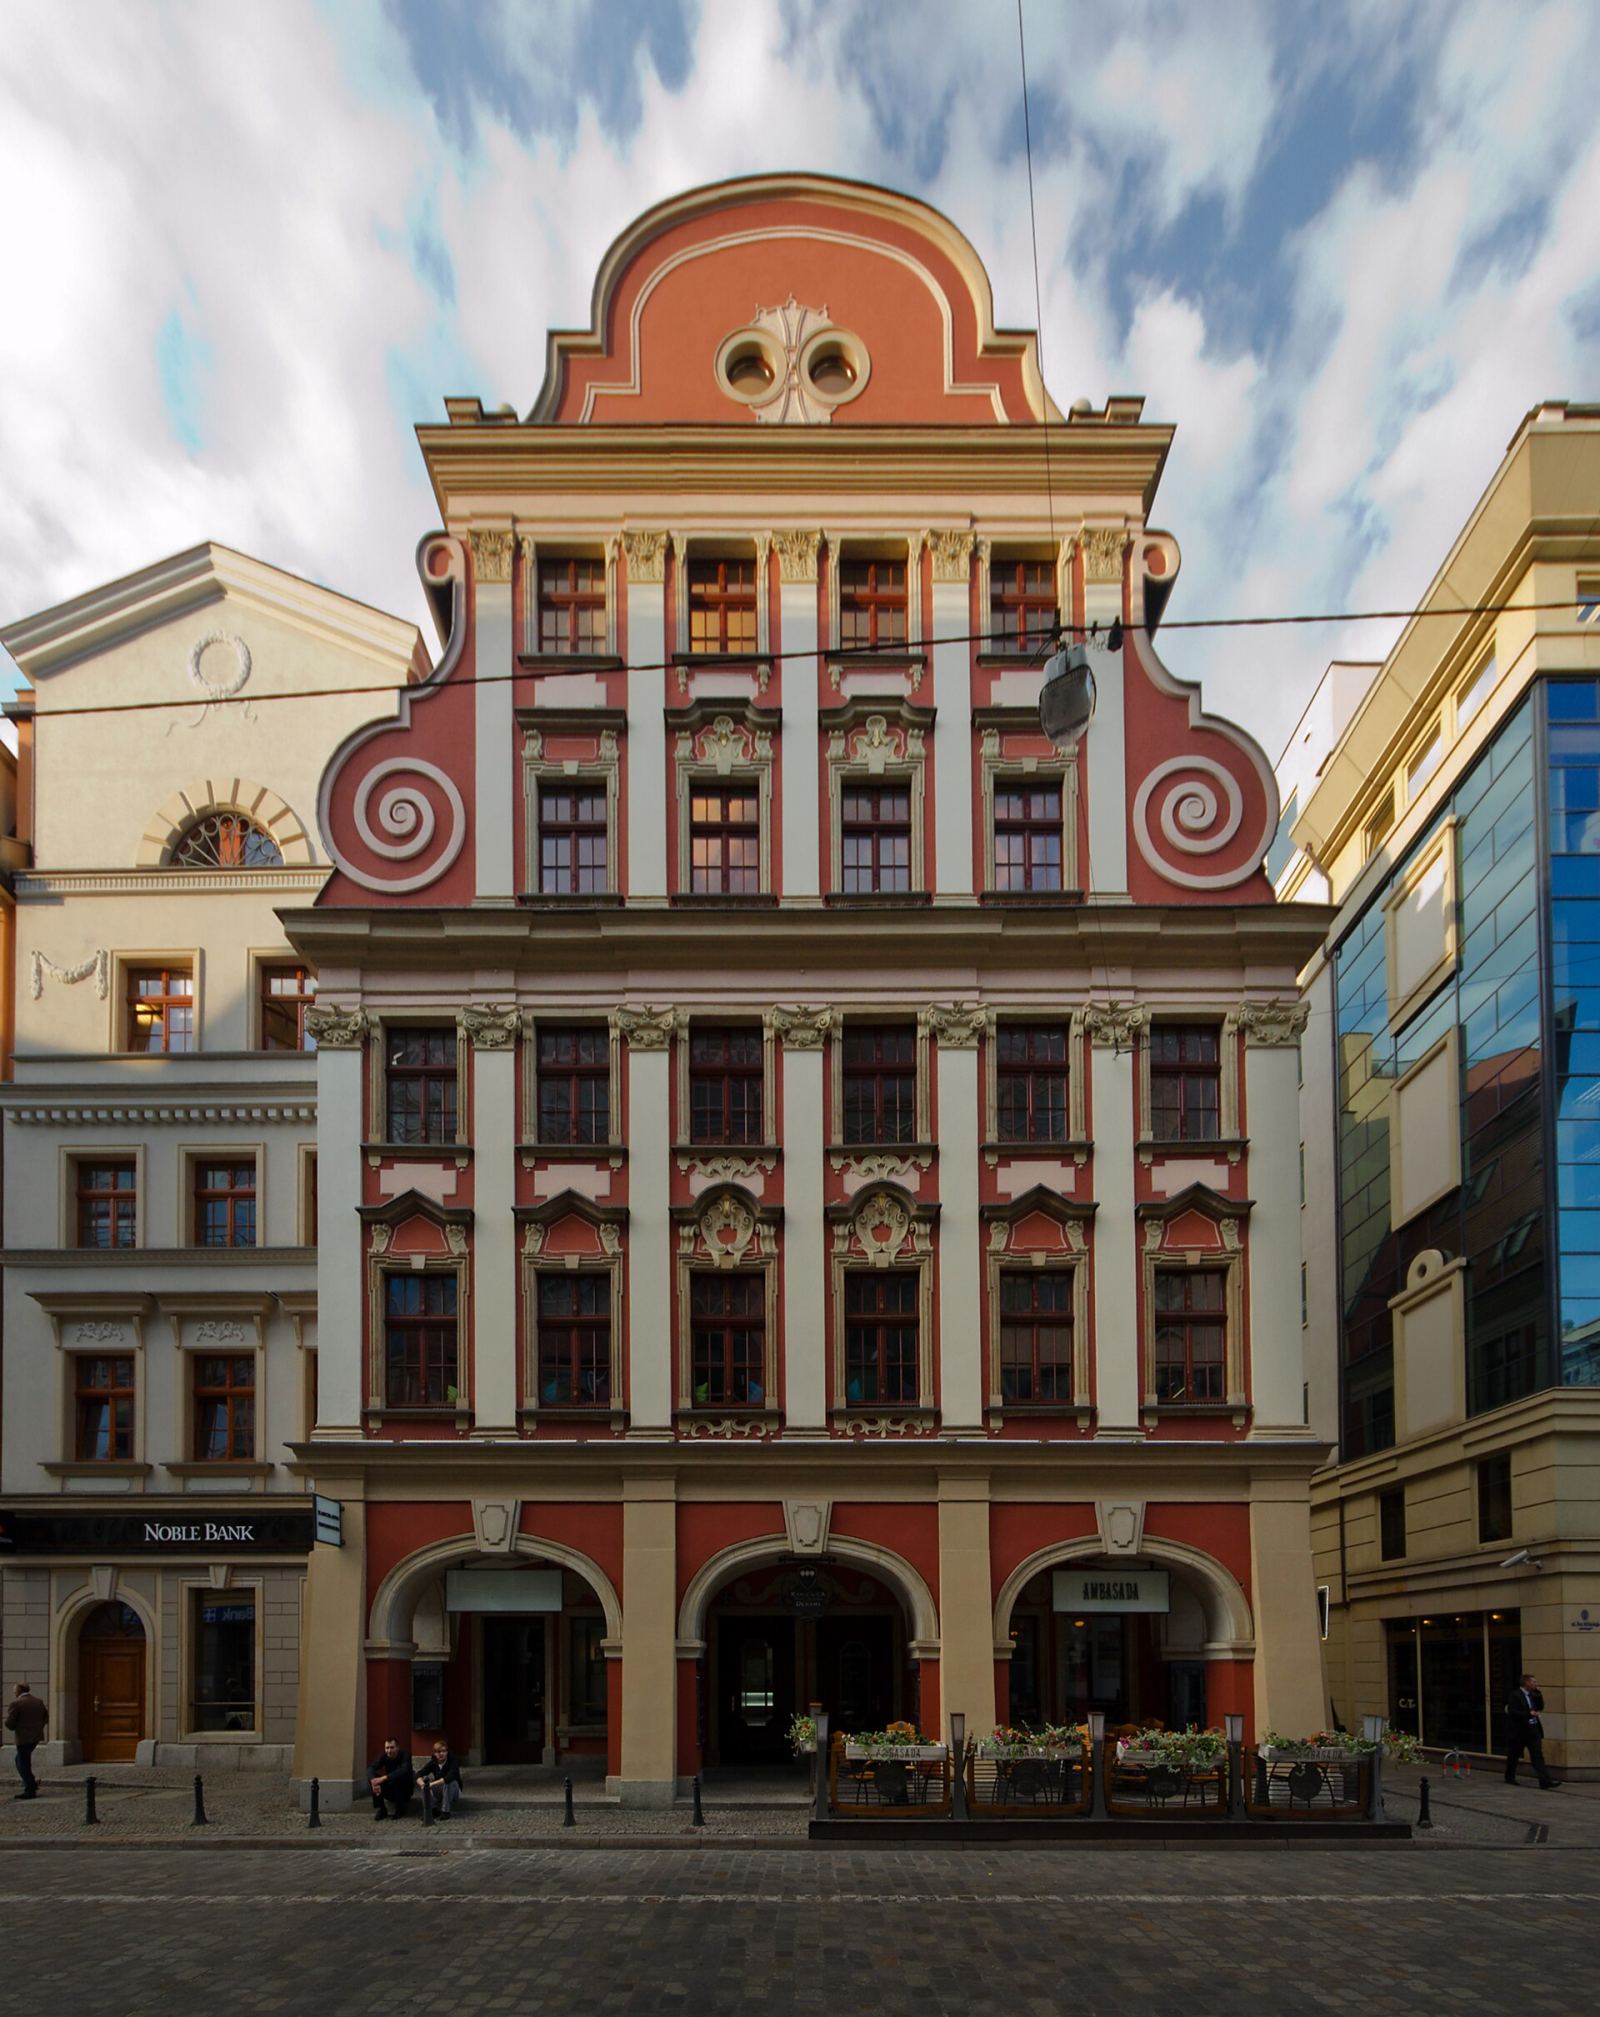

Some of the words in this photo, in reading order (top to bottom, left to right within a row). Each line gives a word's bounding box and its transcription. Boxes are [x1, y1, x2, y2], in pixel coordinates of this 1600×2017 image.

[144, 1523, 201, 1541] NOBLE
[204, 1522, 255, 1541] BANK
[1083, 1582, 1139, 1600] AMBASADA
